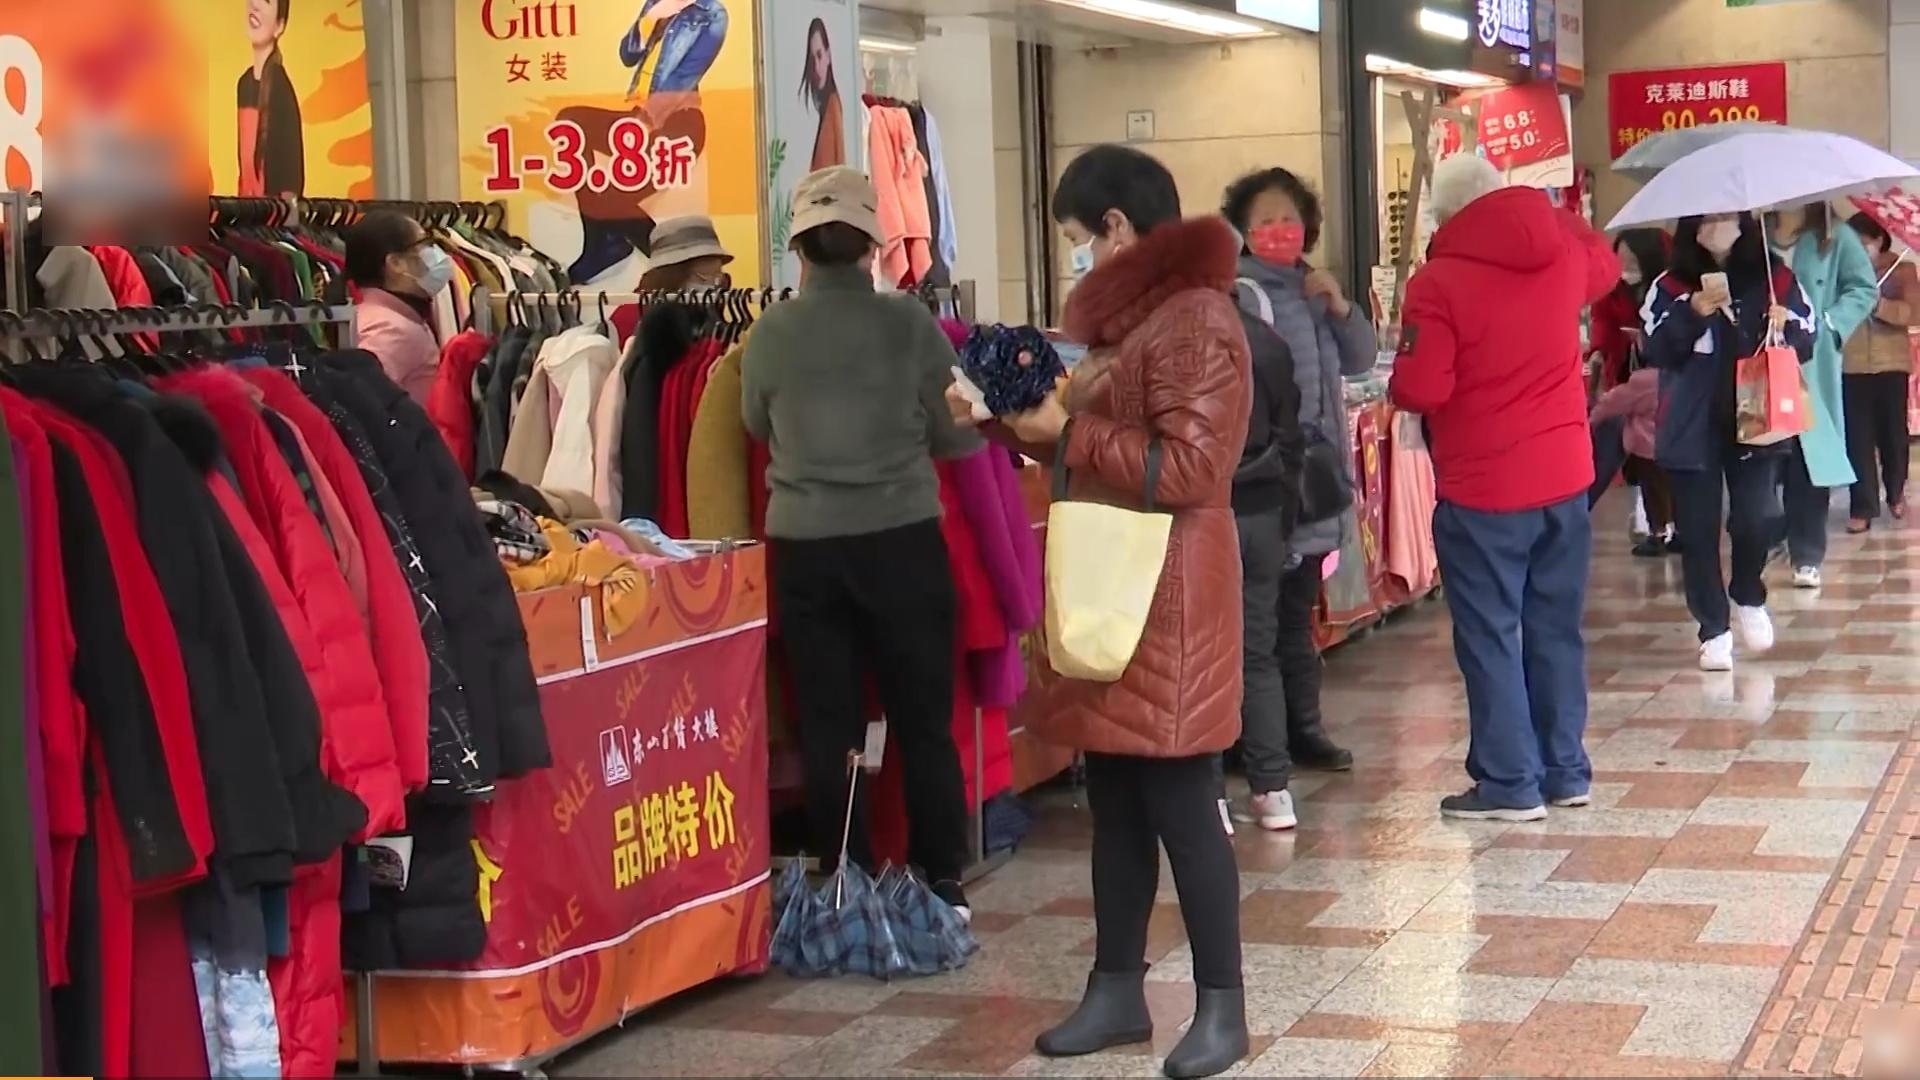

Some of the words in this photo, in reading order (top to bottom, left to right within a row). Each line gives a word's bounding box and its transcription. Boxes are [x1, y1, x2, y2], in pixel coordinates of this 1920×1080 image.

[506, 51, 568, 83] 女装
[1645, 78, 1750, 104] 克莱迪斯鞋
[485, 120, 693, 191] 1-3.8折
[553, 761, 595, 834] SALE
[612, 769, 736, 890] 品牌特价
[536, 894, 584, 958] SALE
